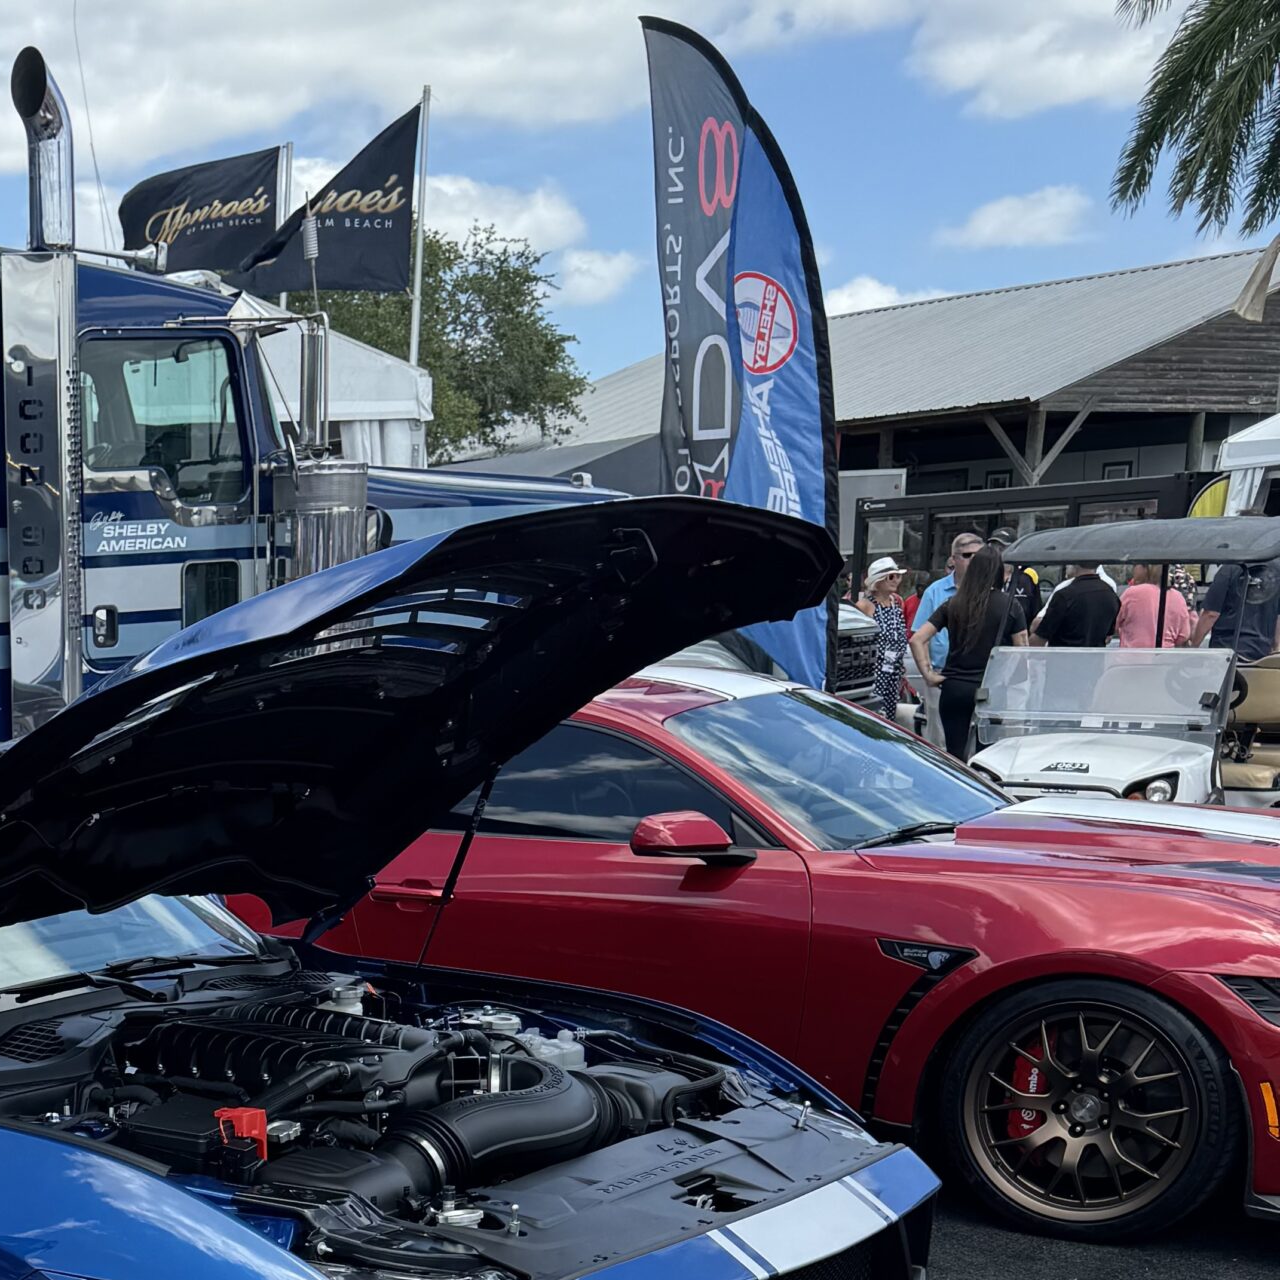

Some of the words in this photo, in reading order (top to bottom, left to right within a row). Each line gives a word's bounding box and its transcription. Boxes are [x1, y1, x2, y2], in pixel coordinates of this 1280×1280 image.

[311, 174, 405, 213] roe's
[145, 186, 270, 245] Monroe's
[345, 218, 393, 229] BEACH
[200, 221, 223, 232] PALM
[229, 217, 262, 228] BEACH
[103, 523, 170, 537] SHELBY
[96, 536, 187, 552] AMERICAN
[596, 1148, 722, 1194] MUSTANG
